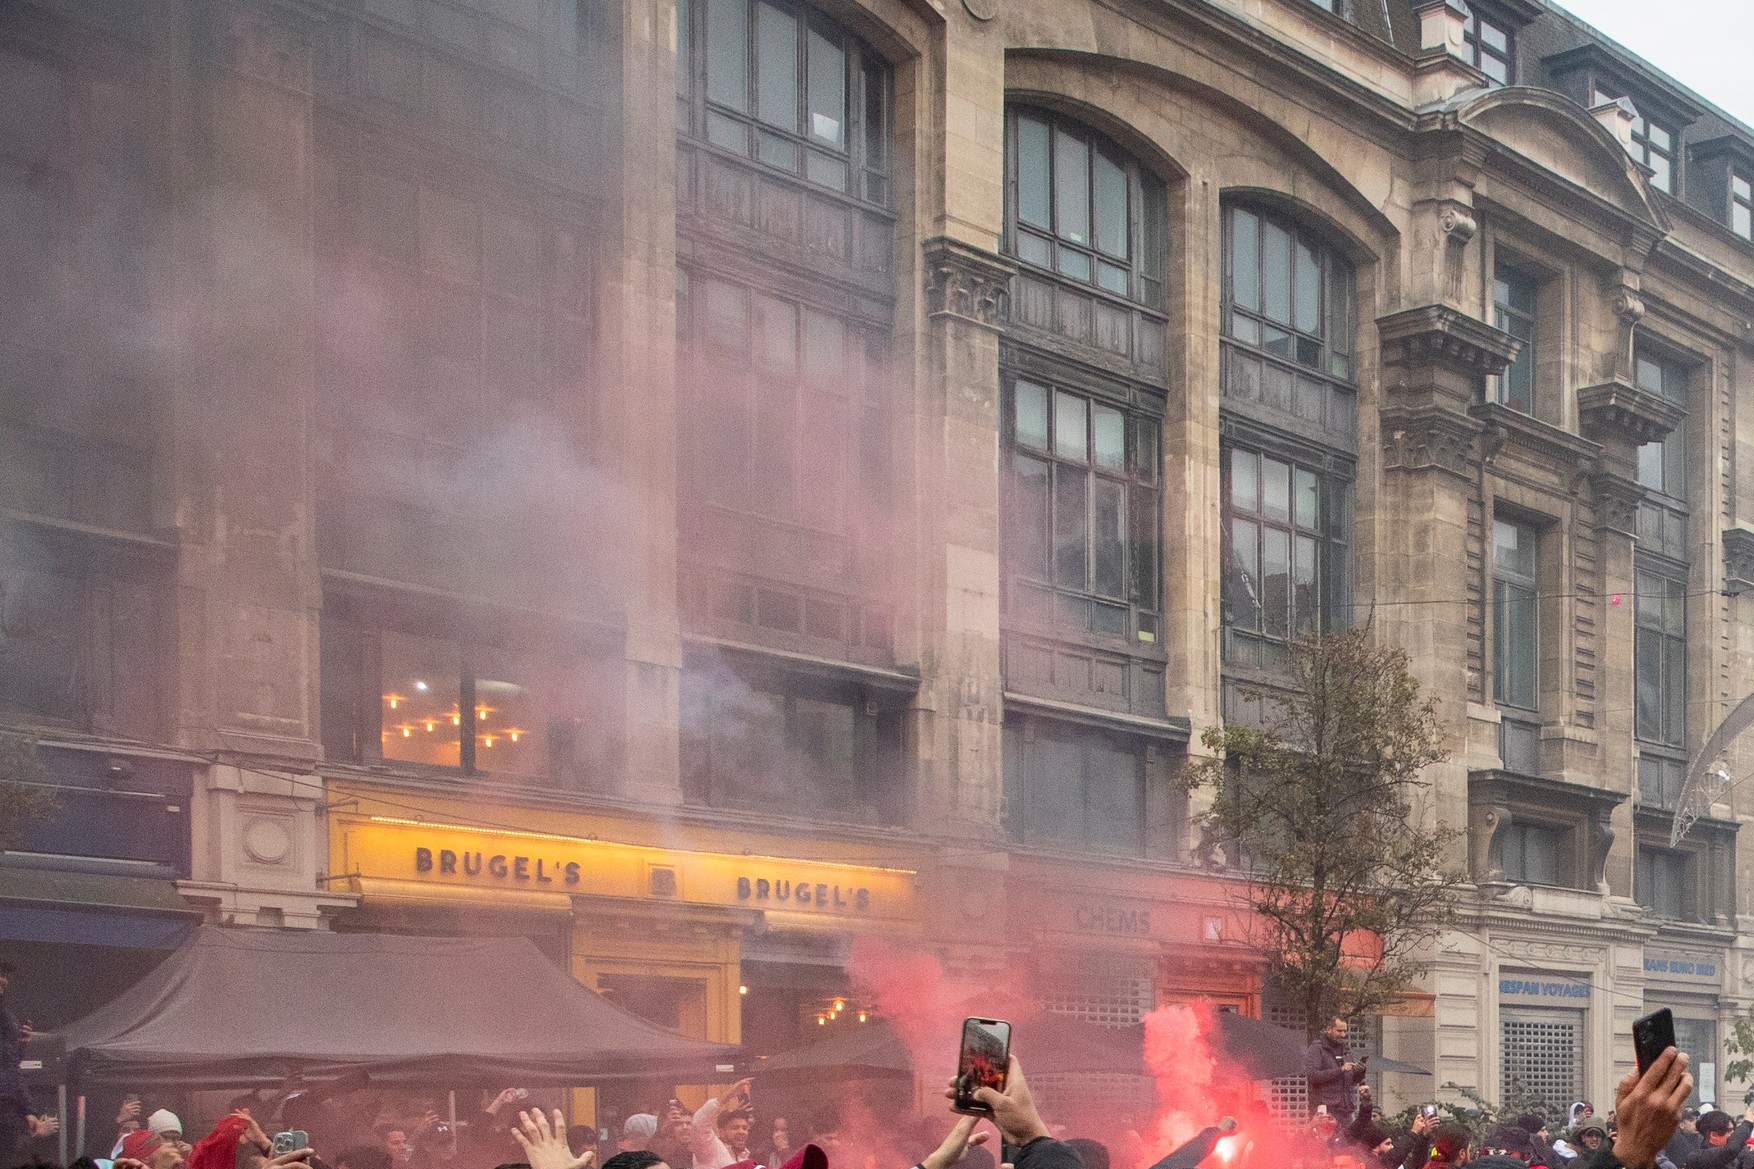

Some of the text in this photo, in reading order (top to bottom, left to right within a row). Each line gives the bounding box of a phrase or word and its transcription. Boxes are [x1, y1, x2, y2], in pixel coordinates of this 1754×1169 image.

[415, 846, 581, 885] BRUGEL'S
[737, 876, 870, 909] BRUGEL'S
[1075, 904, 1150, 935] CHEMS
[1541, 982, 1591, 998] VOYAGES
